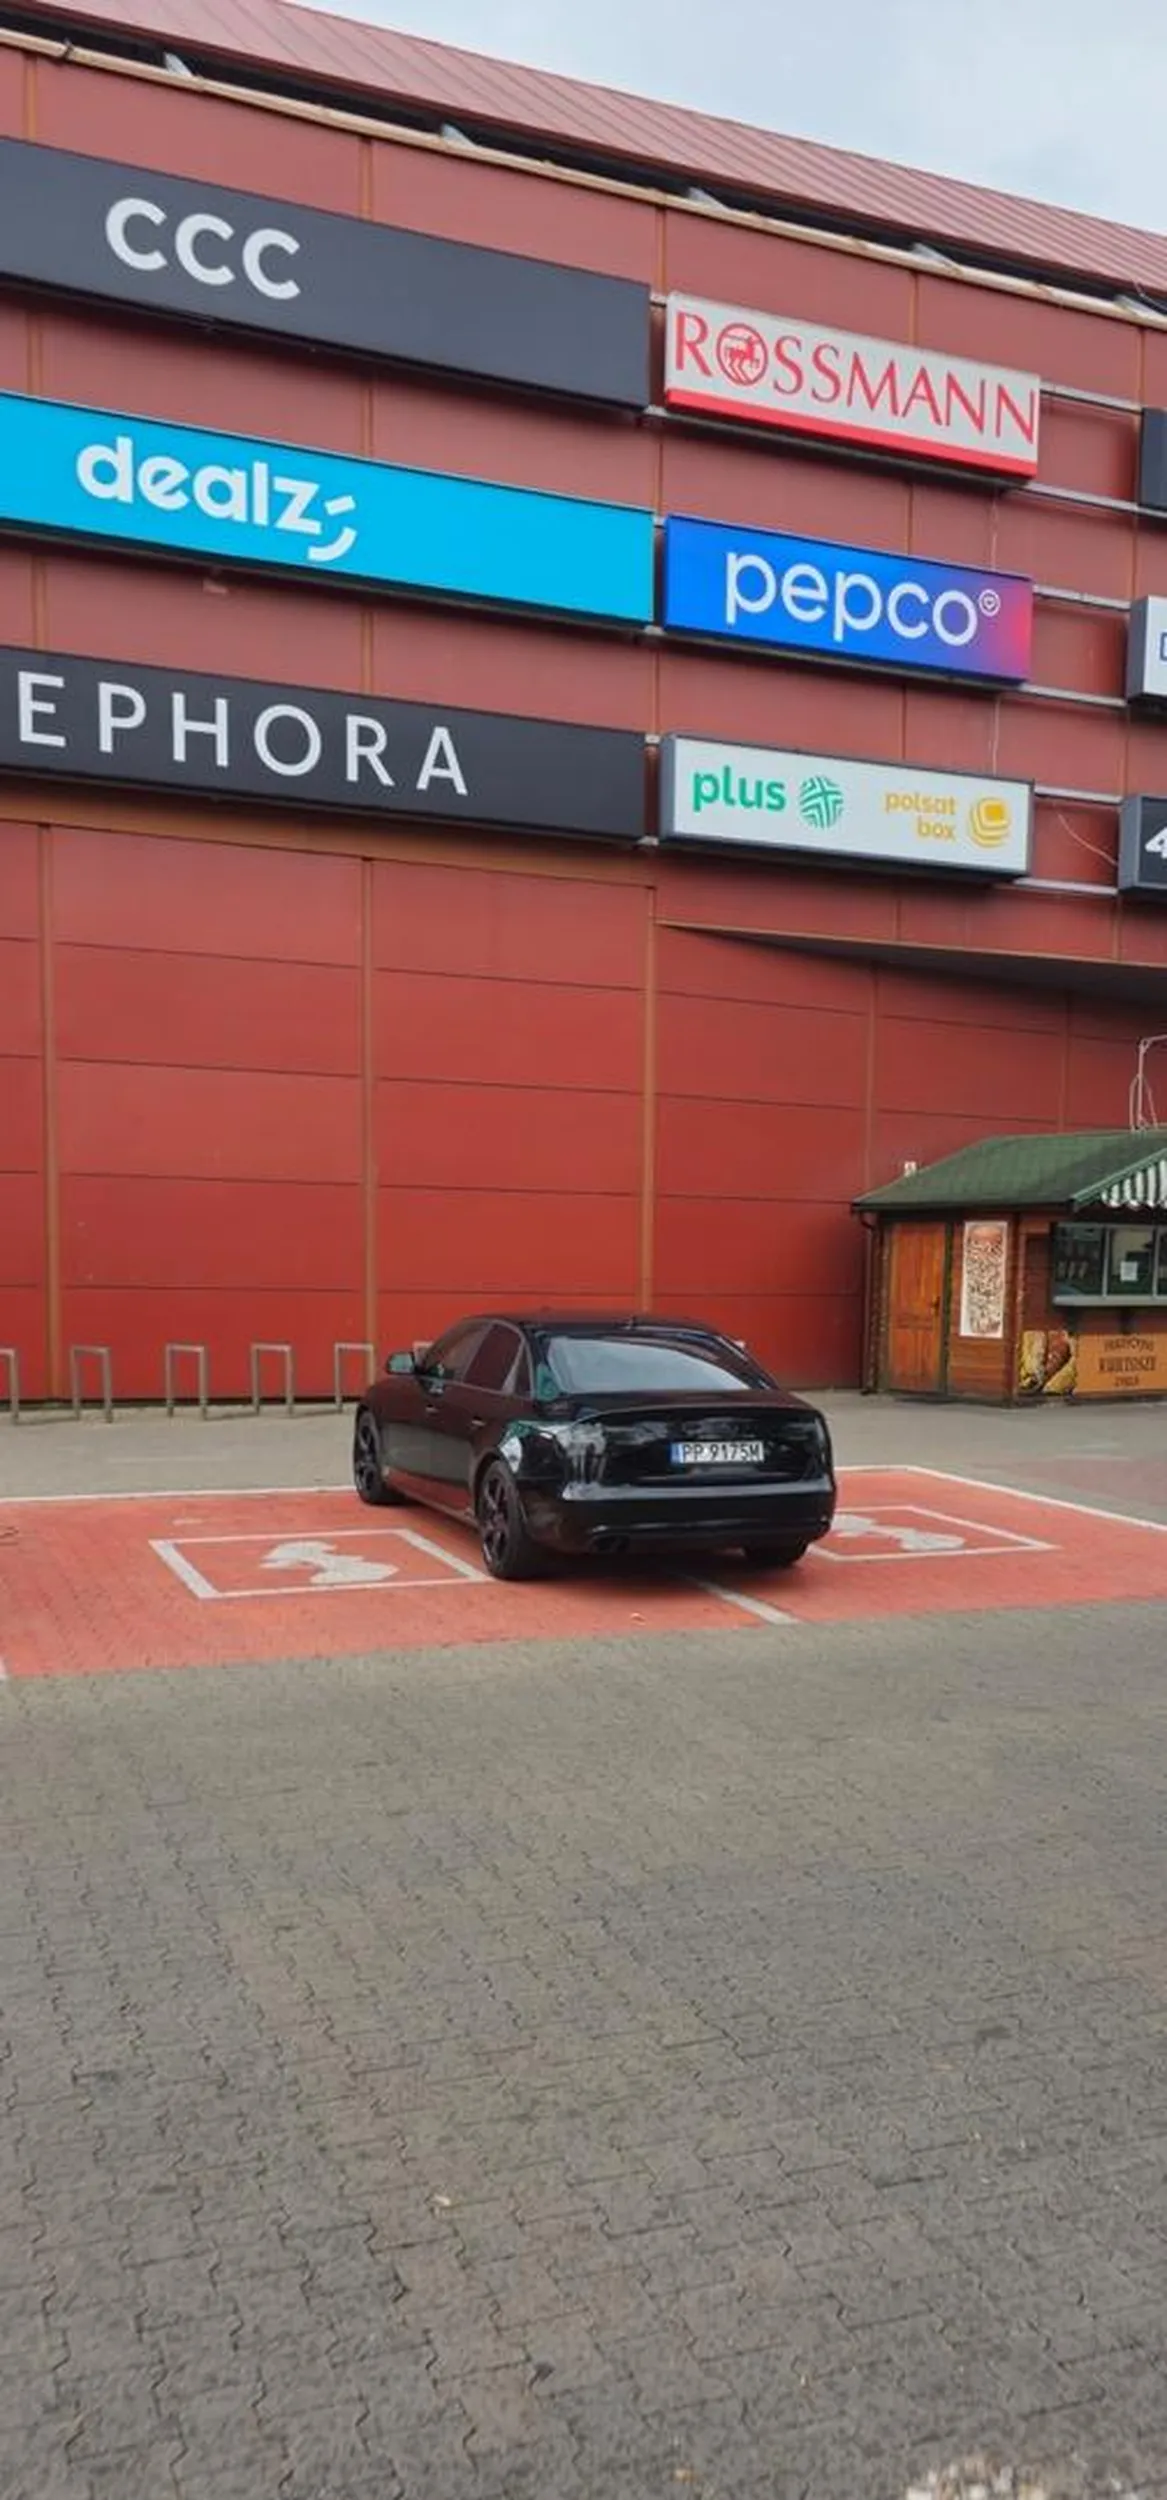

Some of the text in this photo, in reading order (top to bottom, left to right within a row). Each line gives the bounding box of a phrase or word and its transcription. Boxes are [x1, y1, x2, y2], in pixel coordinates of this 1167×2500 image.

[105, 197, 300, 300] CCC
[674, 311, 1036, 445] ROSSMANN
[76, 436, 340, 550] dealz
[725, 551, 978, 647] pepco
[692, 765, 787, 812] plus
[885, 790, 956, 815] polsat
[917, 817, 956, 842] box
[683, 1442, 761, 1463] PP 9175M
